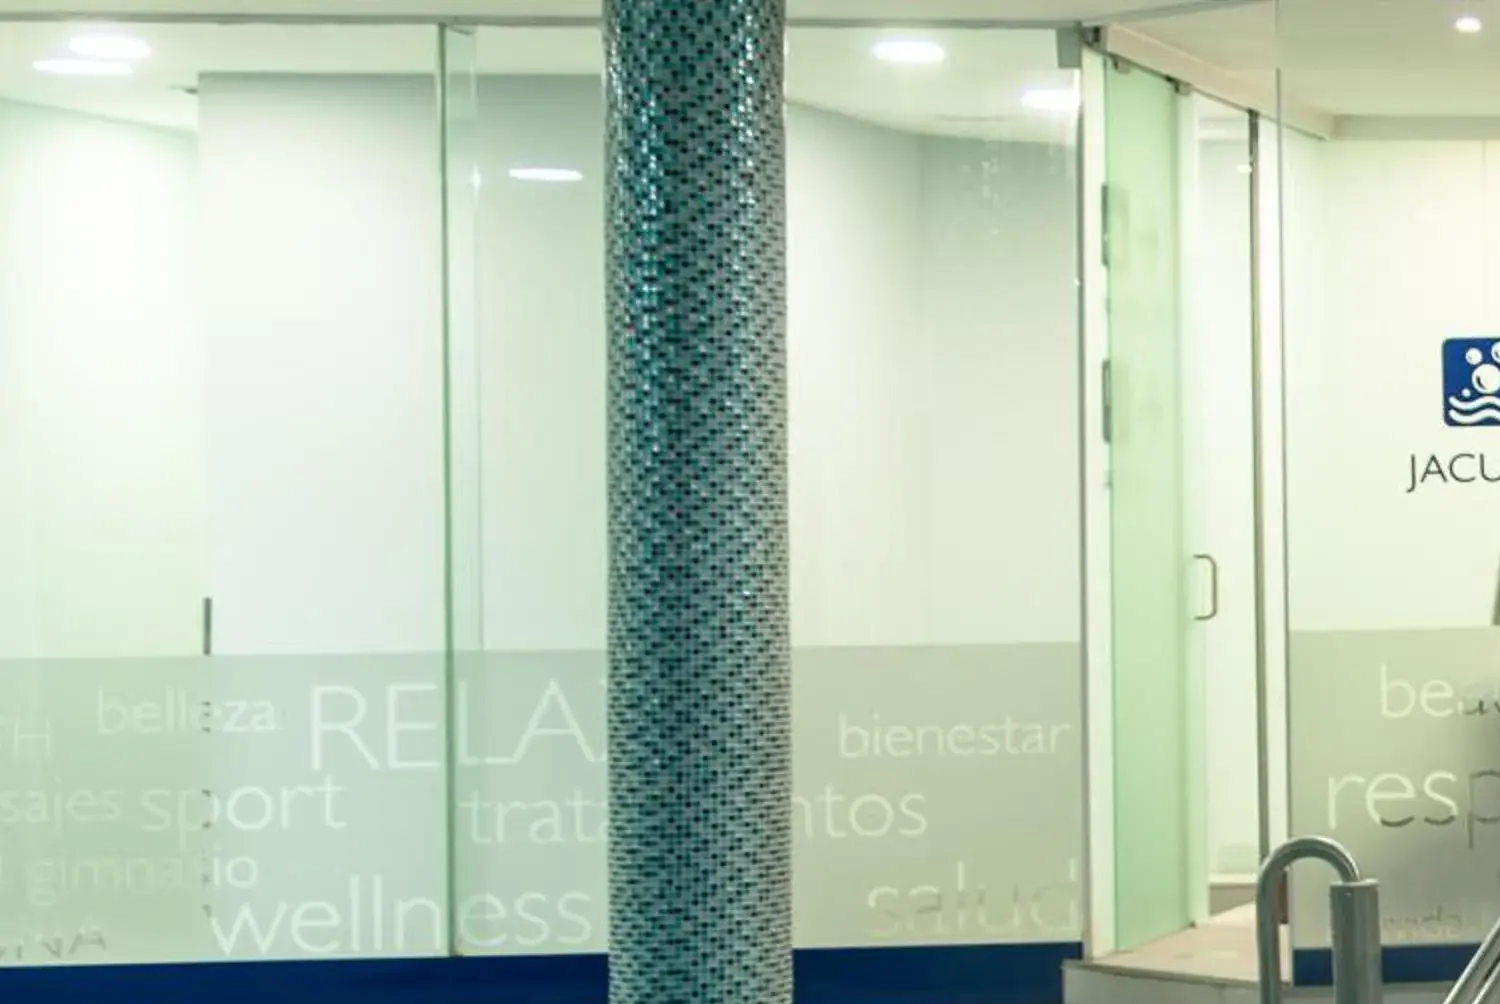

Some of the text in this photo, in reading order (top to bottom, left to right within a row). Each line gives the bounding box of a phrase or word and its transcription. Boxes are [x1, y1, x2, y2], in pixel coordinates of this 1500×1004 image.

[308, 678, 610, 771] RELA
[837, 712, 1071, 759] bienestar
[138, 773, 347, 850] sport
[202, 873, 593, 957] wellness
[867, 857, 1079, 938] salud
